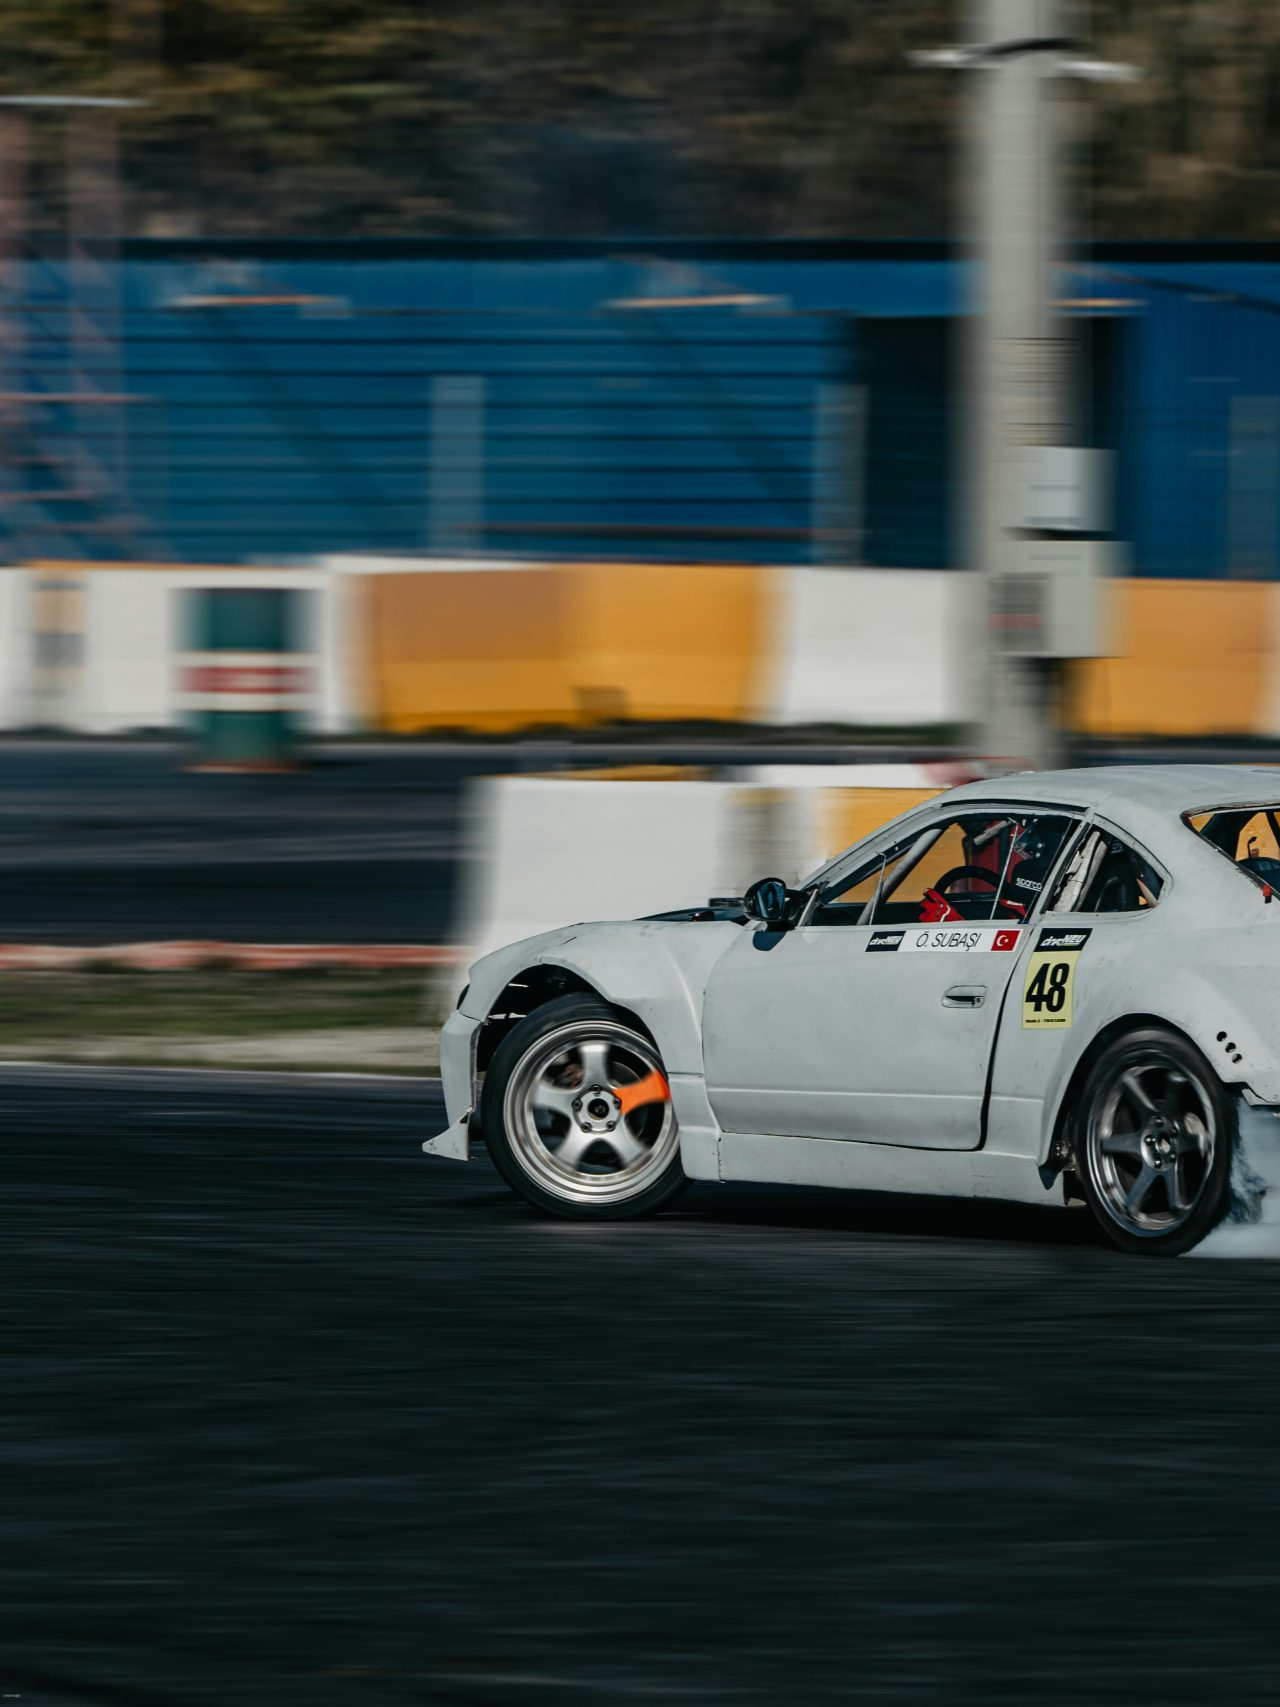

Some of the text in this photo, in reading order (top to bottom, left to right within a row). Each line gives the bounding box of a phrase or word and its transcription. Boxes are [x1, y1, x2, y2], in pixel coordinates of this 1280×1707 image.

[1015, 877, 1043, 891] sparco
[916, 931, 982, 951] Ö. SUBAŞI
[1025, 963, 1070, 1013] 48
